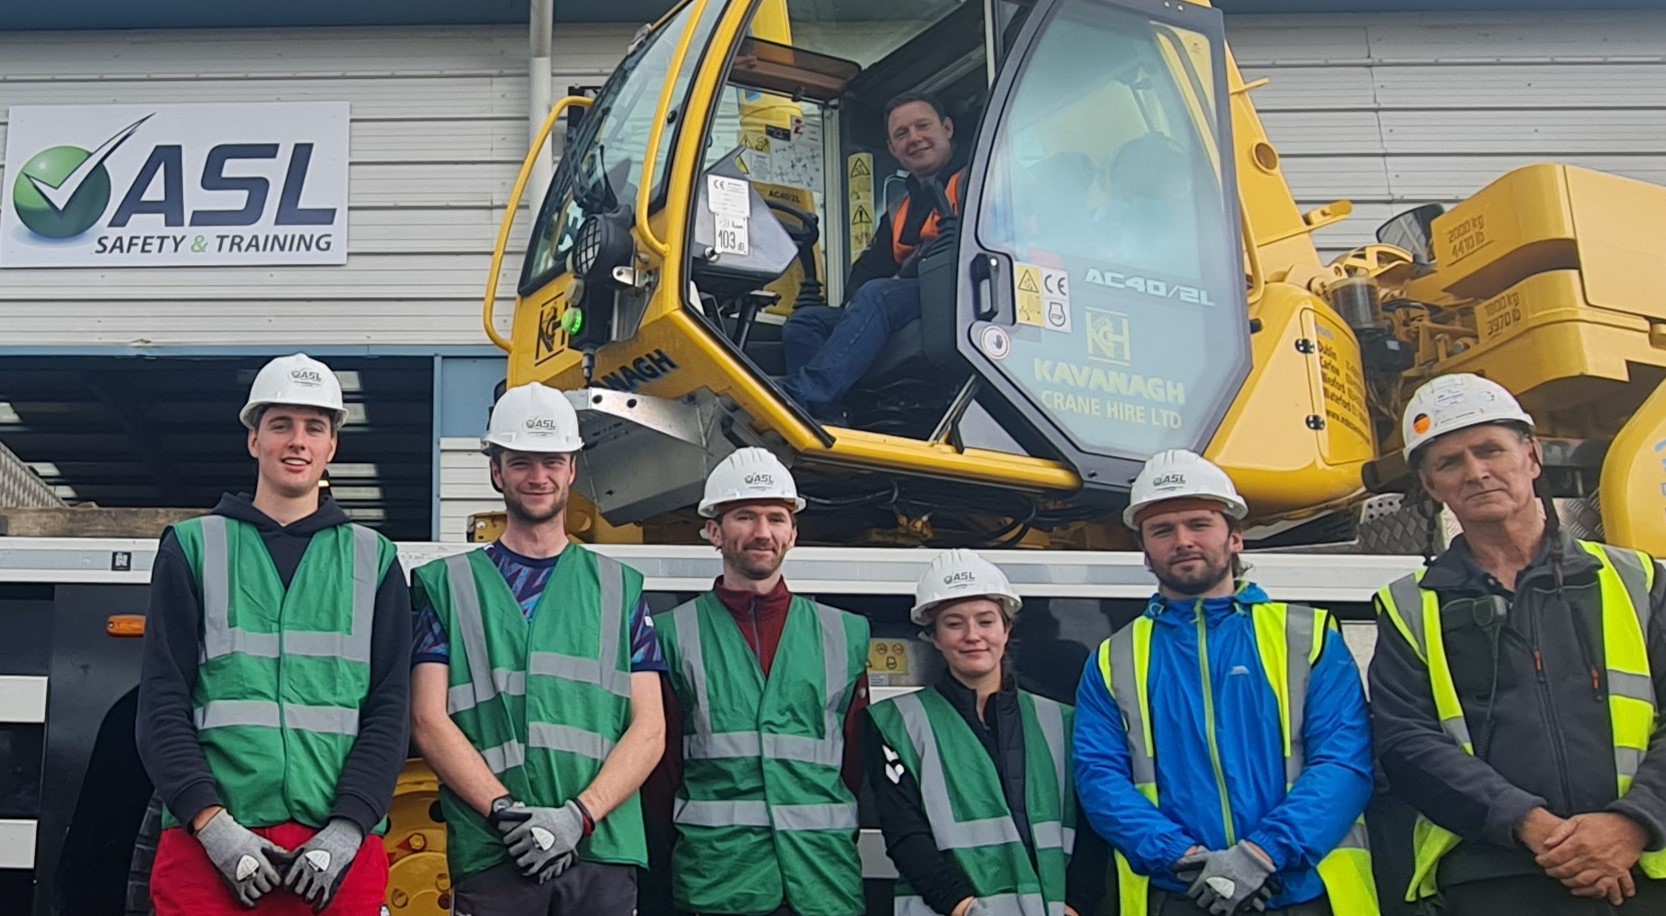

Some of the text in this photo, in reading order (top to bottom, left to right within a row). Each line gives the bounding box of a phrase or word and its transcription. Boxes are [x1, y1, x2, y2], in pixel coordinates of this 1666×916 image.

[107, 143, 337, 228] ASL
[1448, 214, 1485, 244] 2000 kg
[95, 234, 332, 254] SAFETY & TRAINING
[718, 230, 735, 249] 103
[1085, 268, 1216, 307] AC40/2L
[1488, 311, 1511, 336] 3970
[300, 371, 321, 381] ASL
[1033, 359, 1186, 404] KAVANAGH
[1041, 389, 1182, 429] CRANE HIRE LTD
[535, 419, 556, 429] ASL
[753, 474, 774, 483] ASL
[1161, 474, 1185, 484] ASL
[953, 571, 975, 580] ASL
